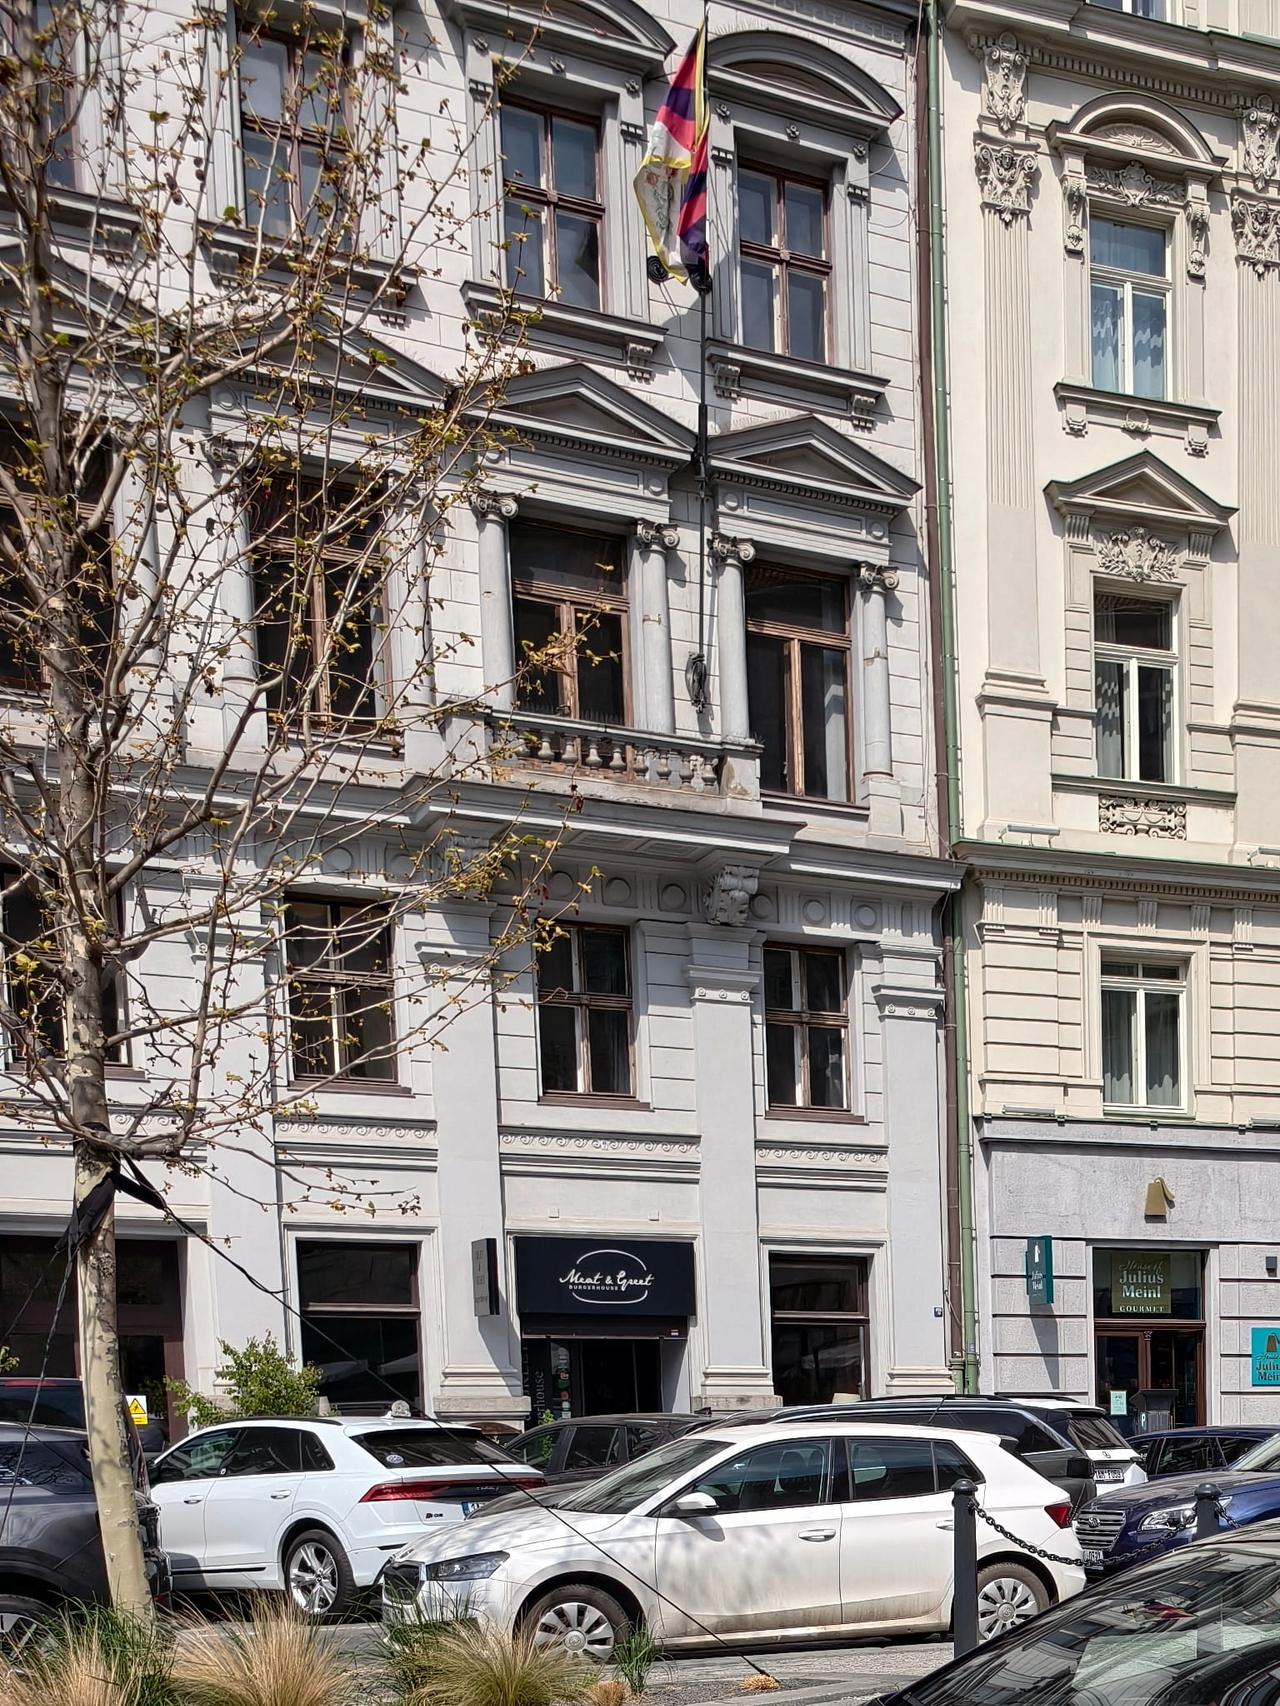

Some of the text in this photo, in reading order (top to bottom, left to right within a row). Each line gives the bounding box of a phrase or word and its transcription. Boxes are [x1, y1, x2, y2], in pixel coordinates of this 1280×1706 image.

[559, 1268, 656, 1291] Meat & Greet
[1119, 1270, 1164, 1284] Julius
[1122, 1285, 1161, 1298] Meinl
[1119, 1305, 1165, 1313] GOURMET
[1141, 1413, 1148, 1427] P
